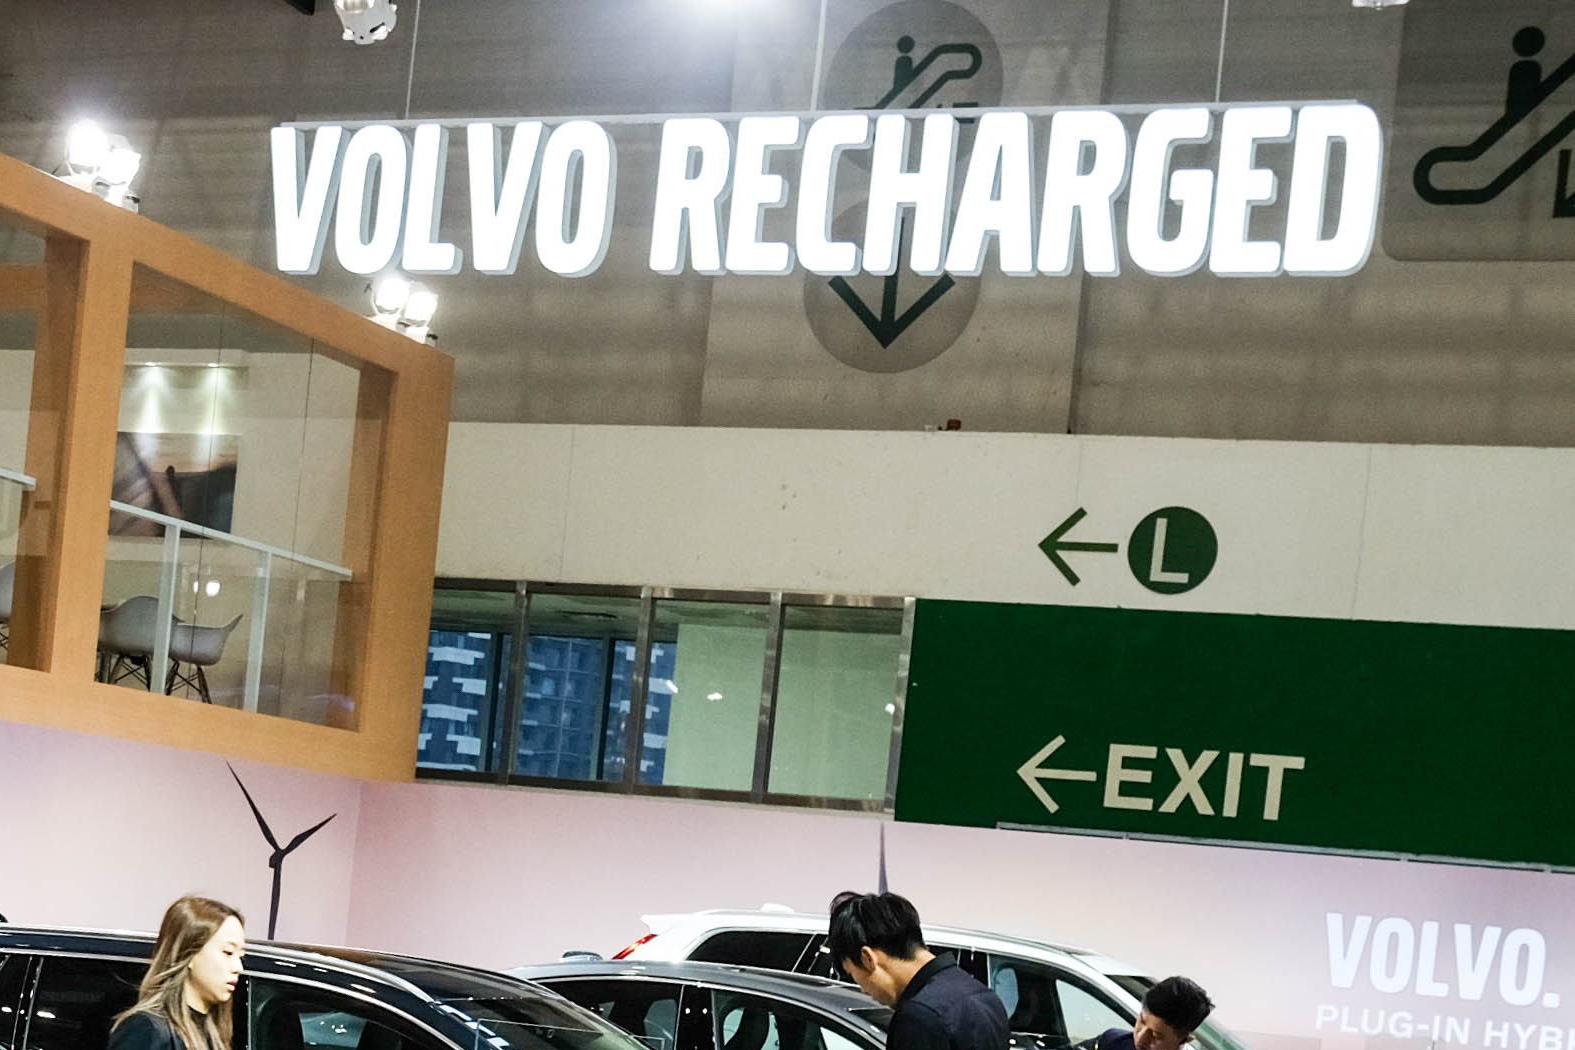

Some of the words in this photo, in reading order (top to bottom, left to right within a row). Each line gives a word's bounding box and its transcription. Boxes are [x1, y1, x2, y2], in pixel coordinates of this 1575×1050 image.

[270, 121, 616, 277] VOLVO
[648, 103, 1384, 278] RECHARGED
[1149, 516, 1190, 584] L
[1103, 743, 1306, 822] EXIT
[1326, 912, 1561, 1009] VOLVO.
[1315, 1004, 1471, 1046] PLUG-IN
